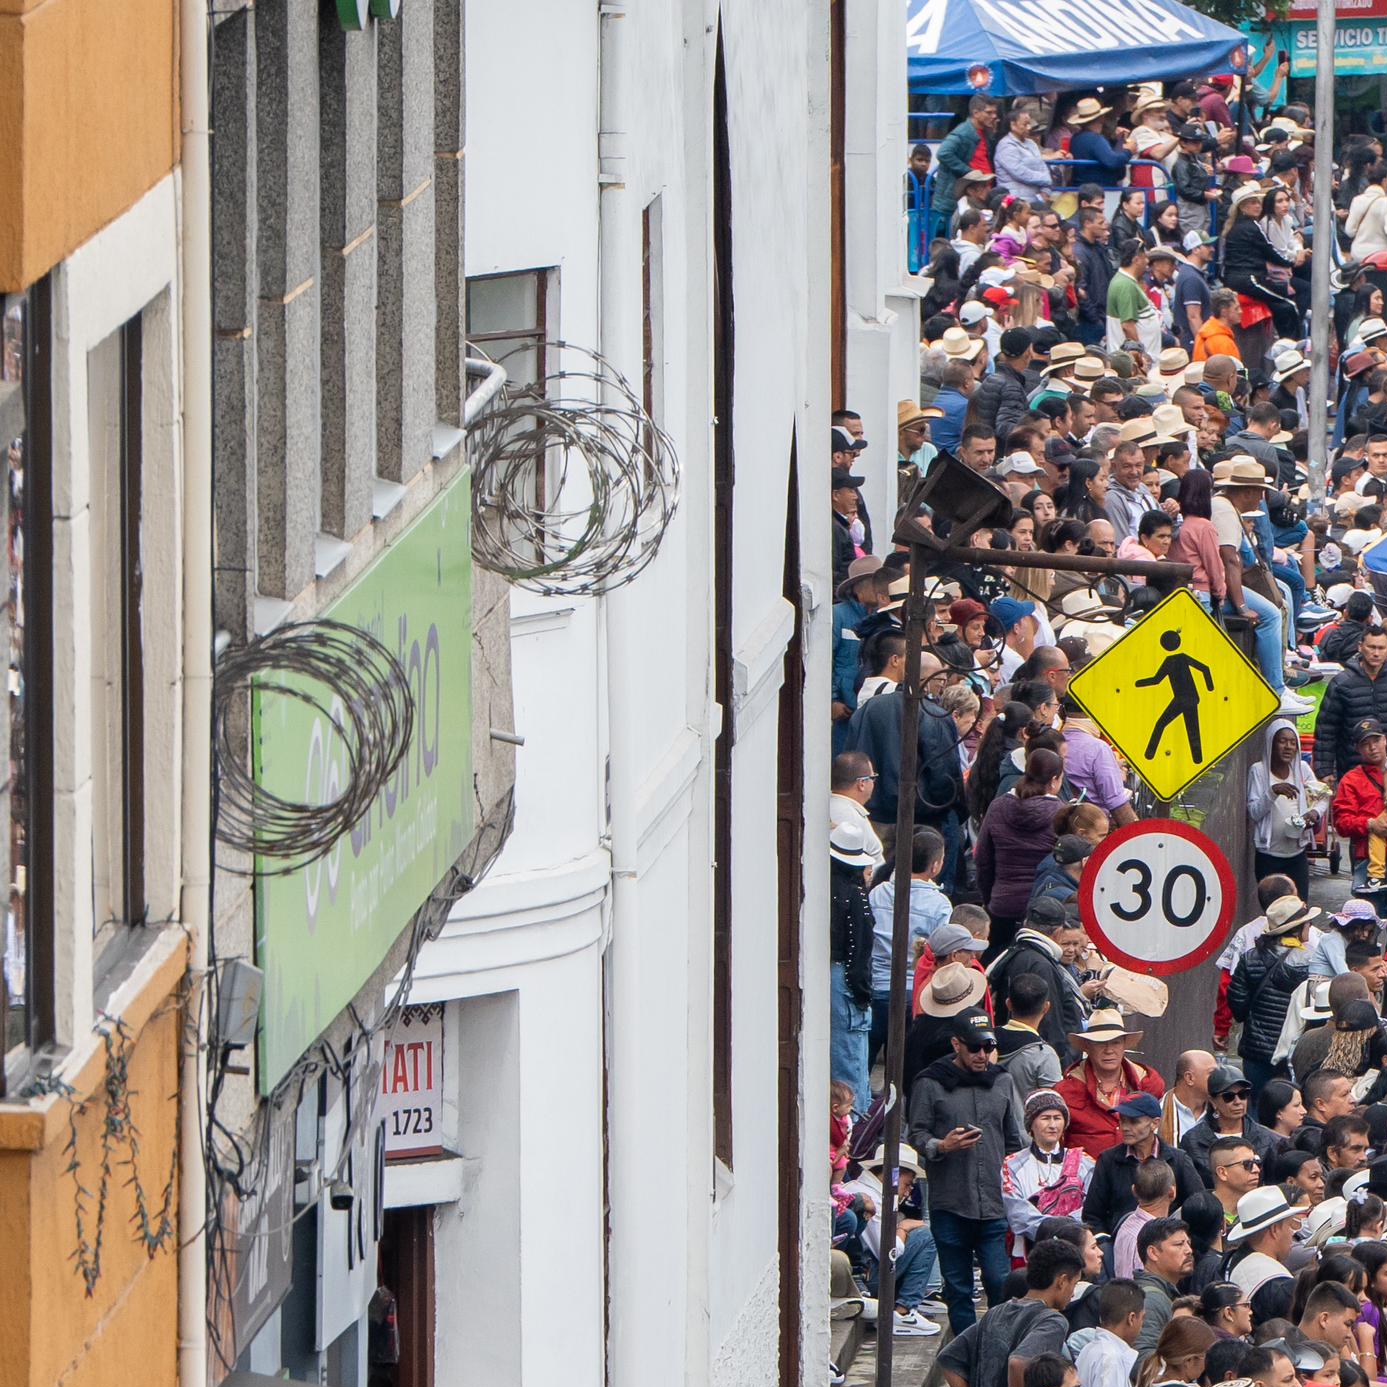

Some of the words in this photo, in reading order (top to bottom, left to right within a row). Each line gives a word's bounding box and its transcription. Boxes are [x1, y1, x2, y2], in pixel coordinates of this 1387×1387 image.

[1296, 27, 1374, 48] SEVICIO
[1109, 858, 1207, 928] 30
[392, 1106, 434, 1136] 1723
